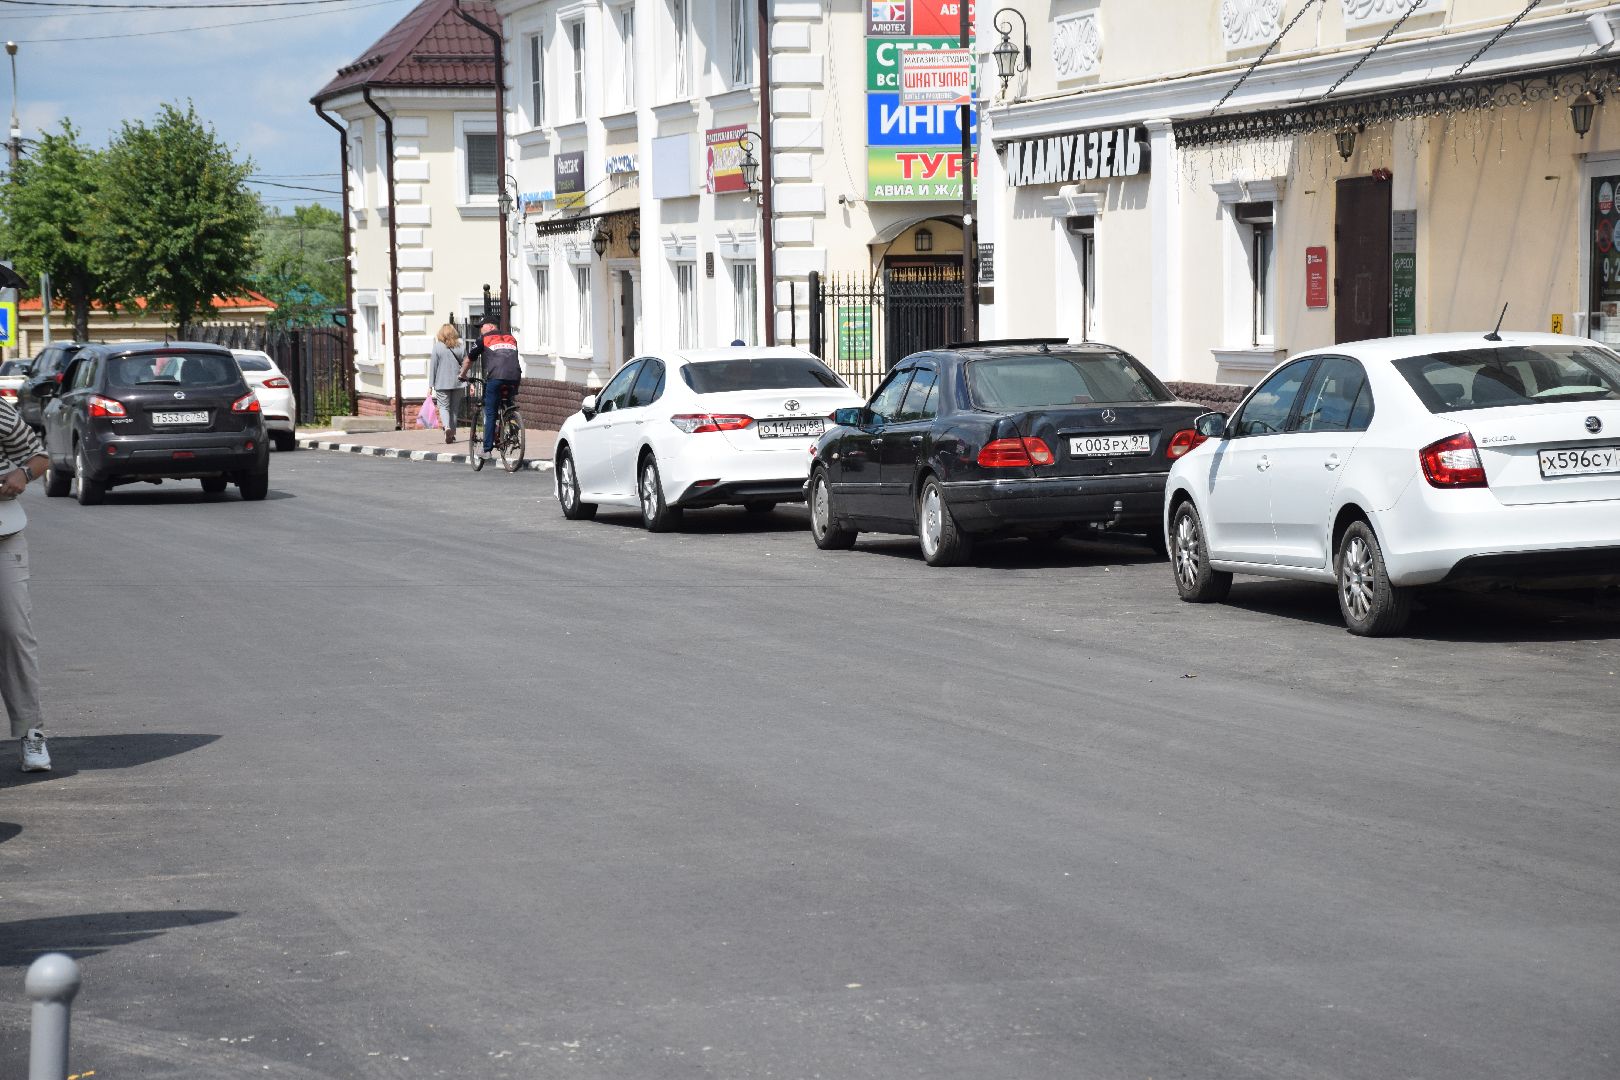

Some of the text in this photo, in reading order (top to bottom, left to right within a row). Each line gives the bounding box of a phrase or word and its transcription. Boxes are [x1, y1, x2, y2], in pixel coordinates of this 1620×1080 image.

[872, 23, 906, 32] АЛЮТЕХ
[904, 55, 969, 64] МАГАЗИН-СТУДИЯ
[904, 71, 968, 88] ШКАТУЛКА
[1006, 127, 1141, 187] МАДМУАЗЕЛЬ
[874, 185, 914, 196] АВИА
[918, 185, 930, 196] И
